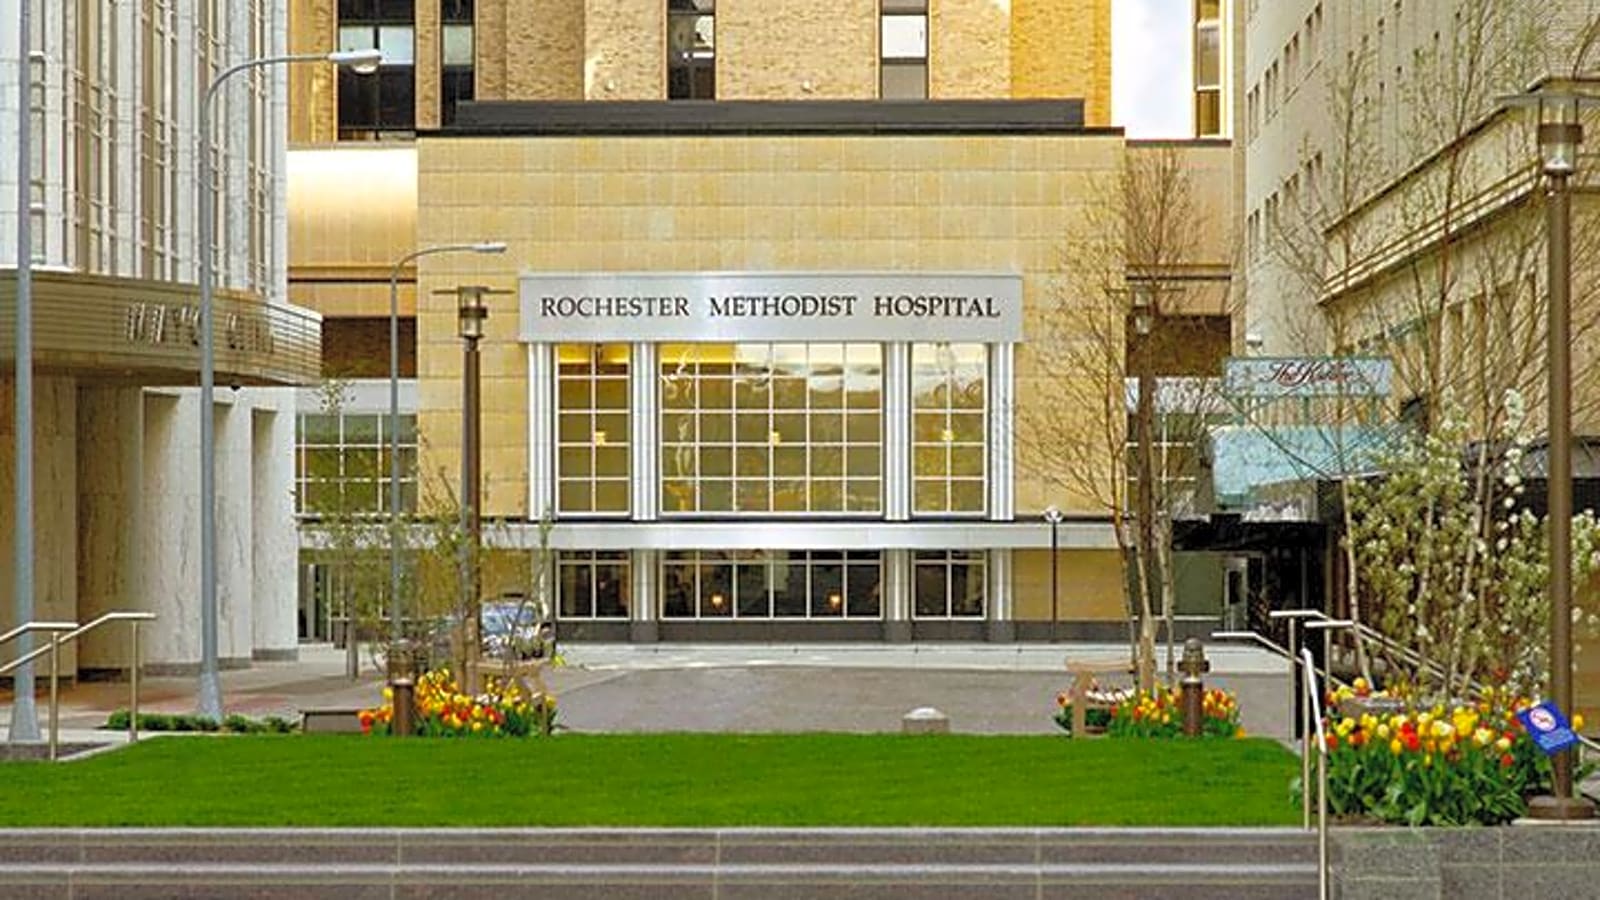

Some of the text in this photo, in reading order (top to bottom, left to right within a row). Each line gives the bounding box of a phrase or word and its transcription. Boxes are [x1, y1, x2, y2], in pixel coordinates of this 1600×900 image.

[541, 295, 1001, 317] ROCHESTER METHODIST HOSPITAL
